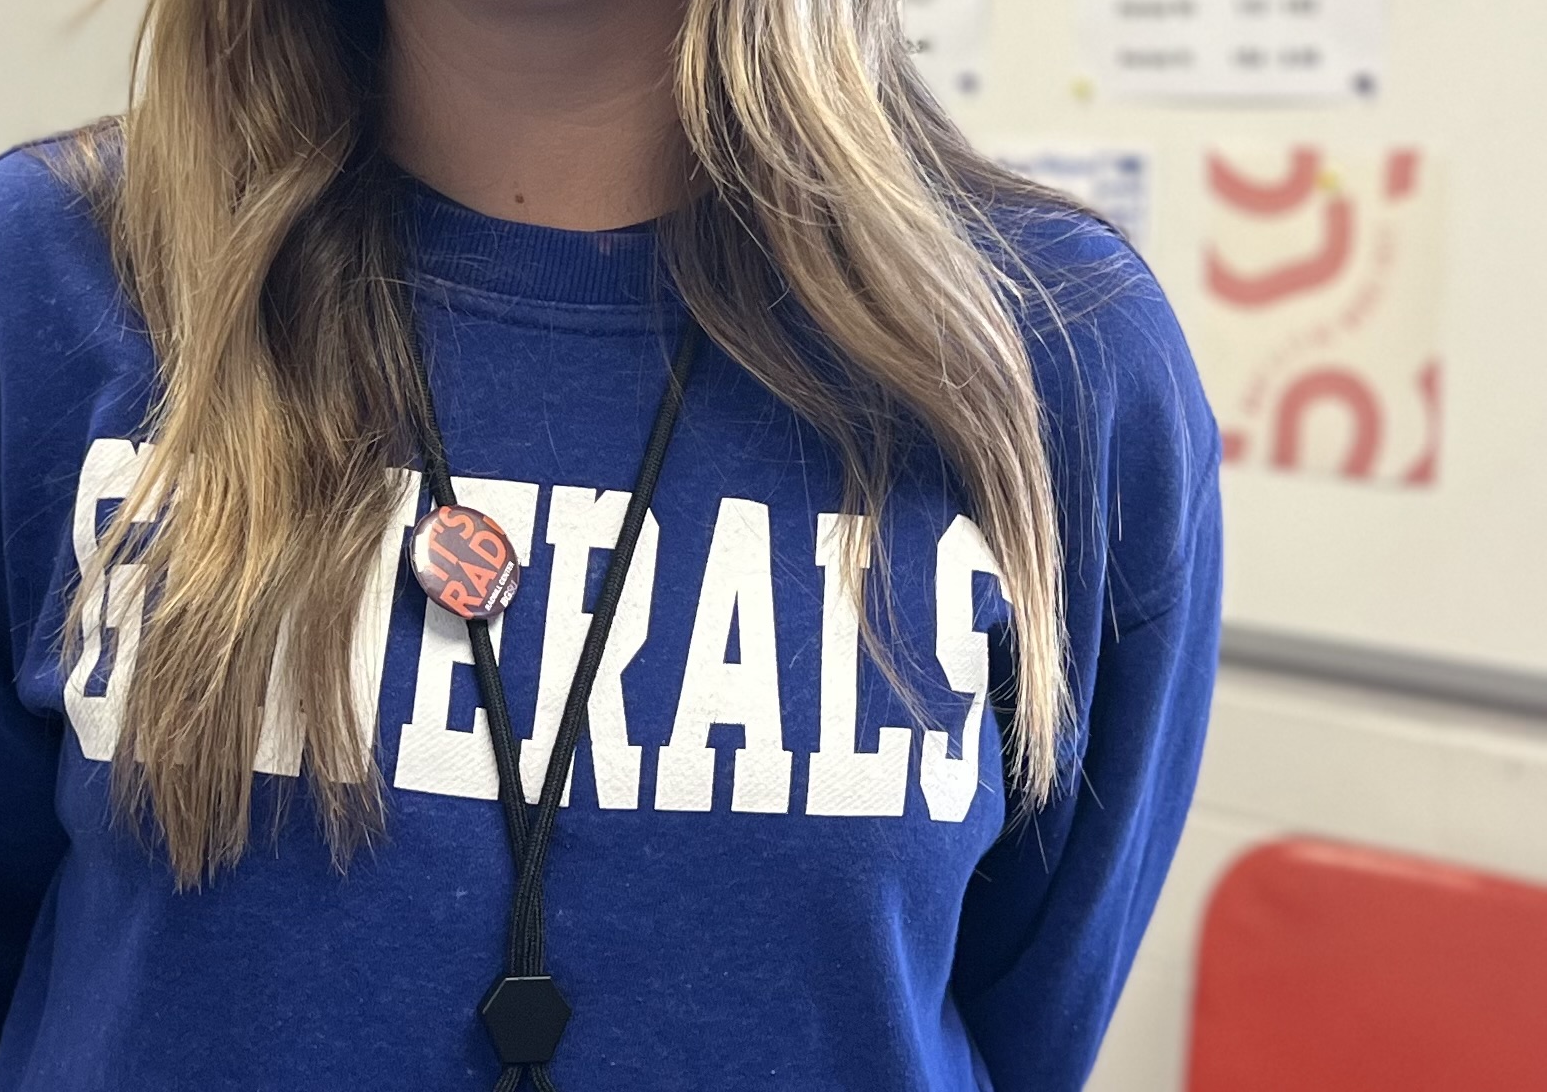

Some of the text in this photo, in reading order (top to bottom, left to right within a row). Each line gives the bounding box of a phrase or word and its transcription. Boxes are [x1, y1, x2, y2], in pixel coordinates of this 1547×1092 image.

[499, 560, 515, 586] CENTER
[500, 579, 518, 608] BGSU
[63, 437, 1016, 822] GNERALS
